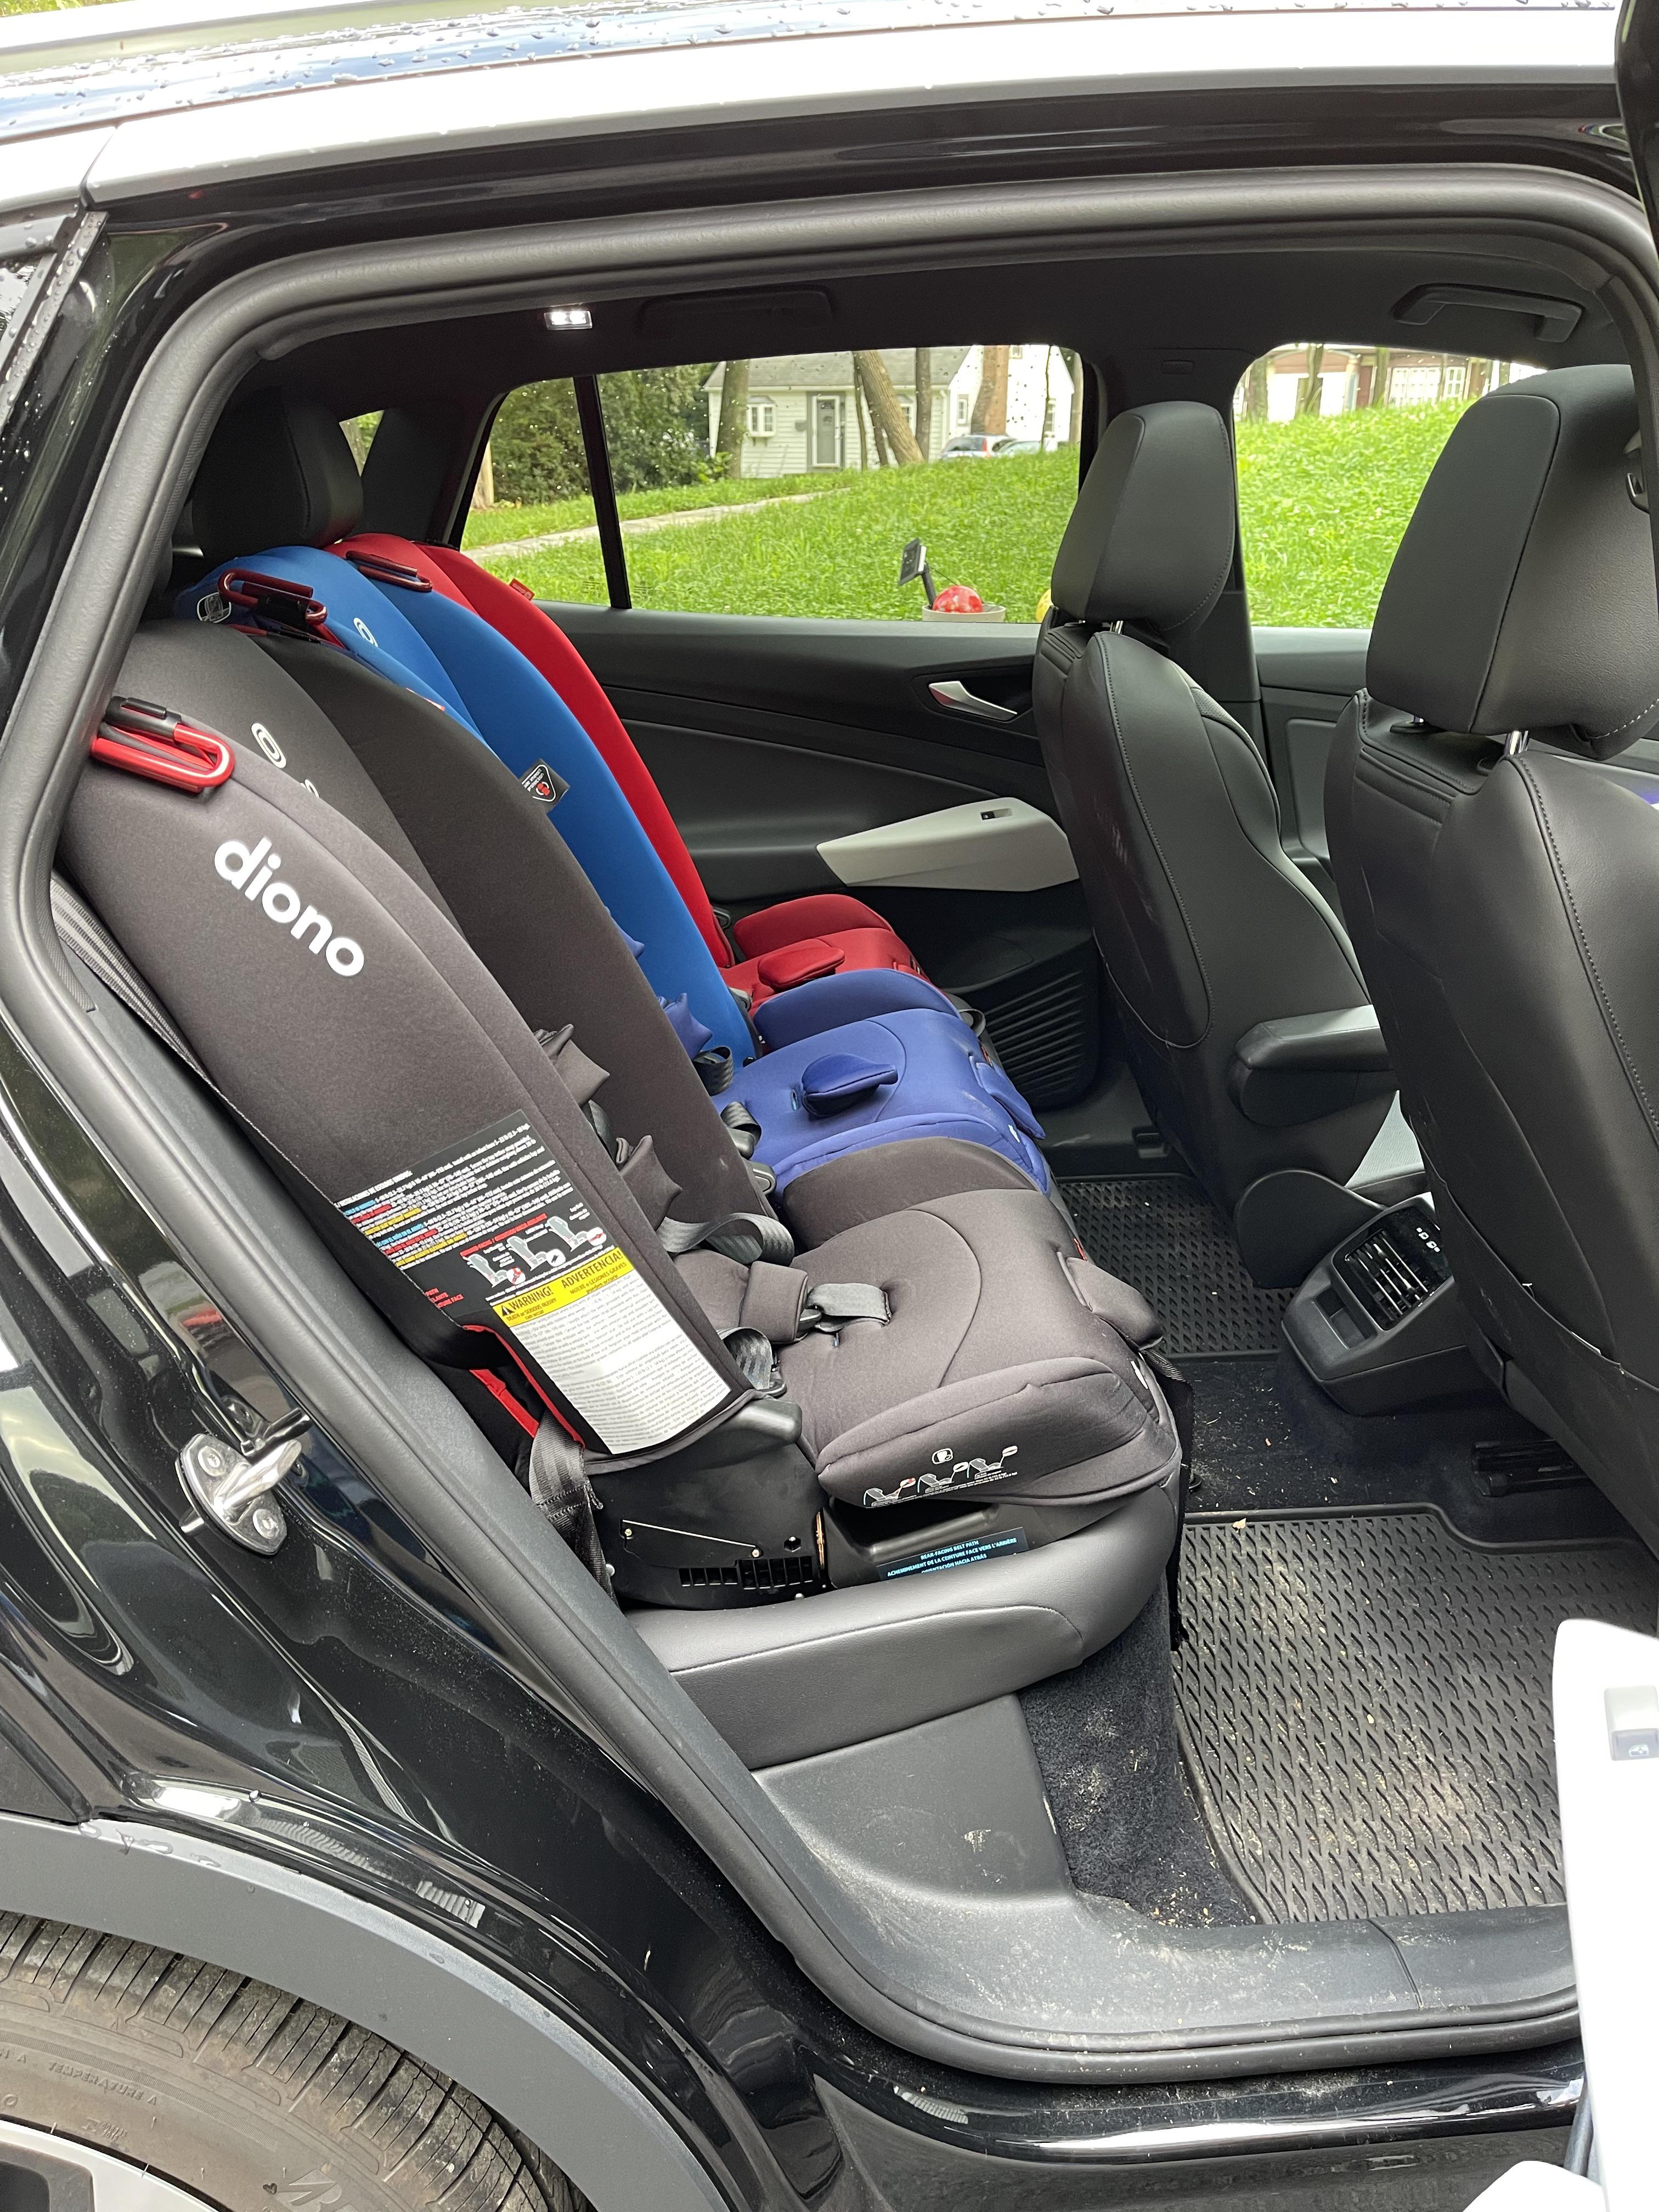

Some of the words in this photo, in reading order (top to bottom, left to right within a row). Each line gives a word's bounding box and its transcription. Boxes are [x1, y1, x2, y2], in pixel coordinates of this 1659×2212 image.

[214, 837, 365, 977] diono
[560, 1250, 623, 1289] ADVERTENCIA!
[609, 1261, 627, 1273] GRAVES
[509, 1286, 554, 1310] WARNING!
[887, 1562, 927, 1577] ACHEMINEMENT
[941, 1551, 966, 1562] CEINTURE
[966, 1548, 979, 1556] FACE
[921, 1547, 953, 1560] REAR-FACING
[953, 1544, 966, 1553] BELT
[966, 1541, 979, 1549] PATH
[955, 1558, 970, 1566] HACIA
[48, 2062, 144, 2101] TEMPERATURE
[146, 2095, 157, 2106] A
